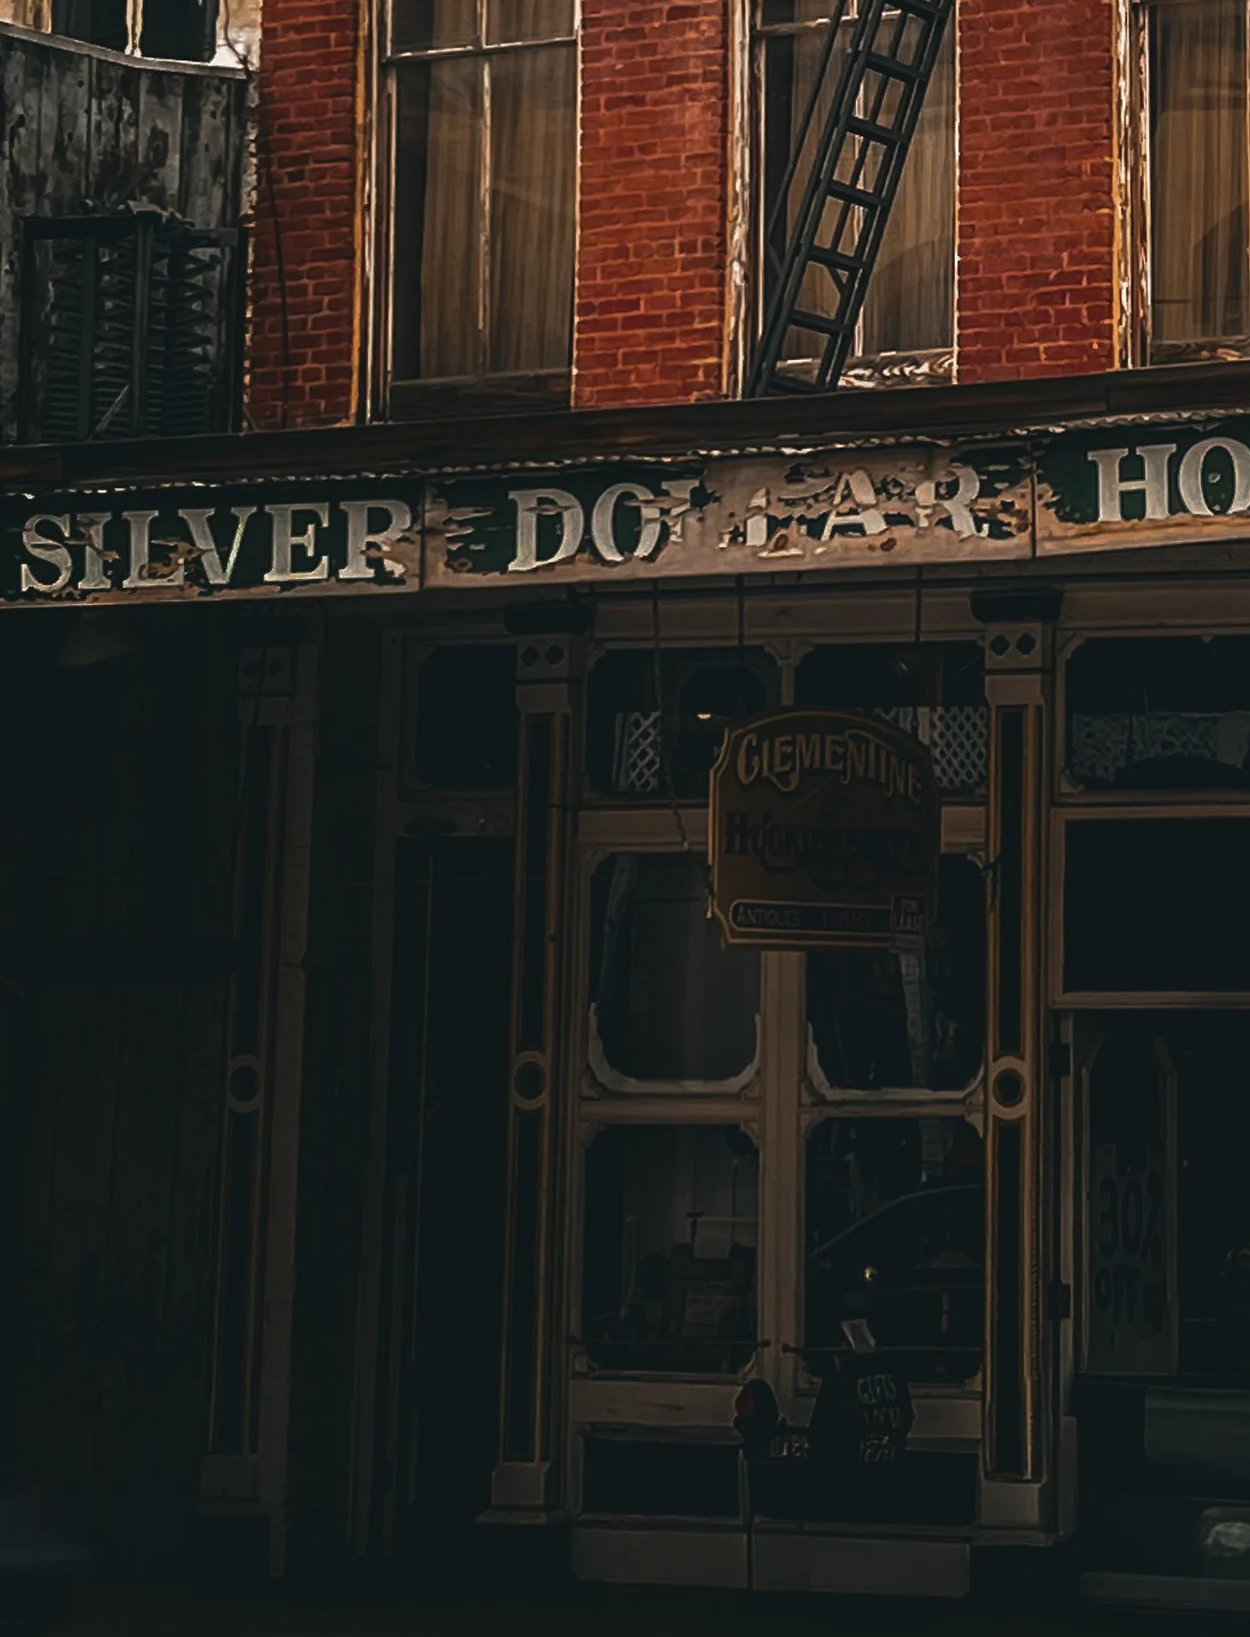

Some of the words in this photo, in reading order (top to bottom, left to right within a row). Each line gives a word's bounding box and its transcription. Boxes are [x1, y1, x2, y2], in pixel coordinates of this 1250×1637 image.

[20, 498, 414, 592] SILVER
[736, 728, 923, 804] CLEMENTINE
[1097, 1170, 1164, 1266] 30%
